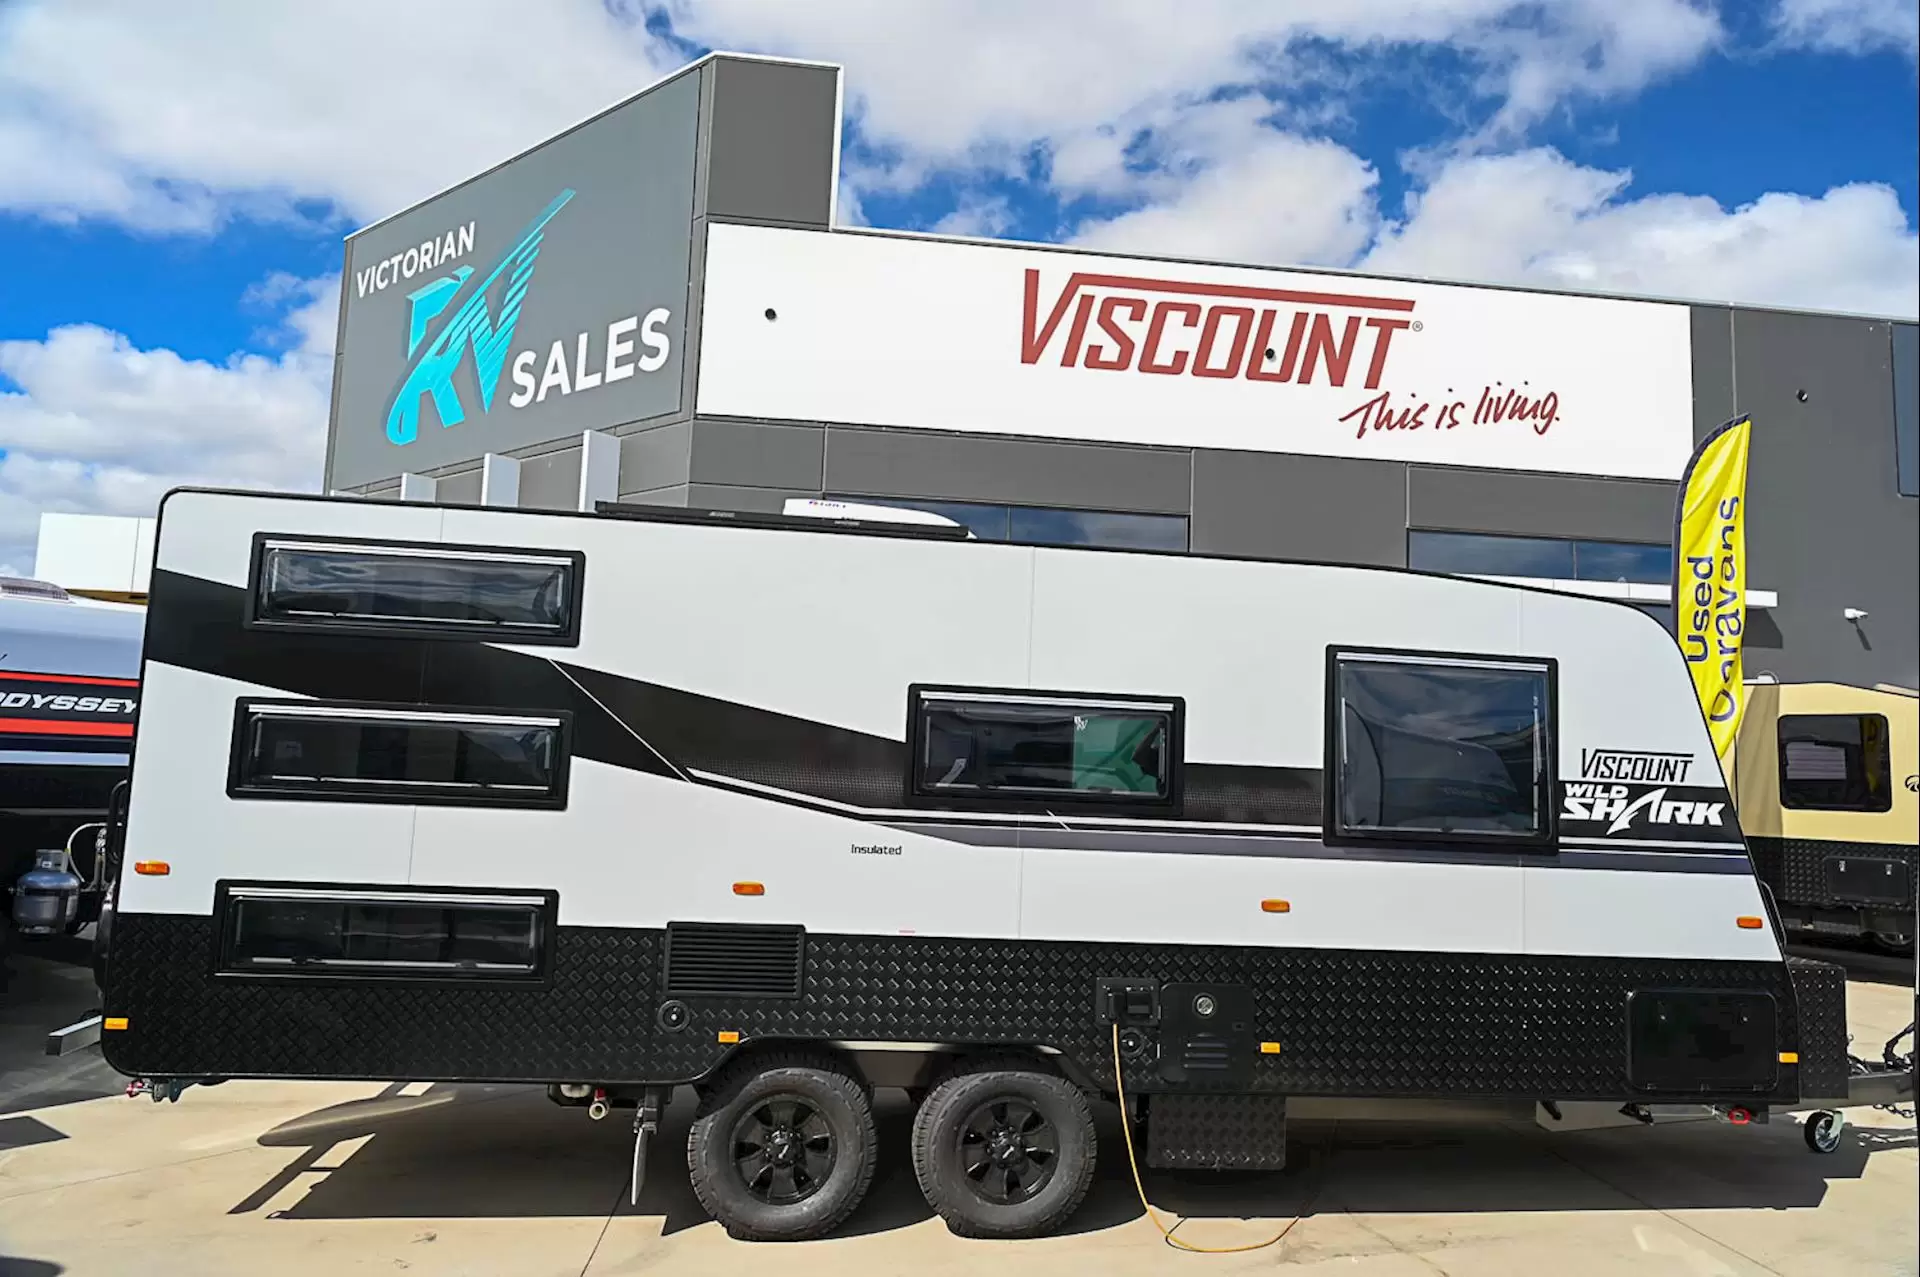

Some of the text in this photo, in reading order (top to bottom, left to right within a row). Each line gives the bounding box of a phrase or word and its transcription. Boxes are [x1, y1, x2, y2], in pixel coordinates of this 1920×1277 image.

[356, 220, 476, 298] VICTORIAN
[1020, 268, 1416, 390] VISCOUNT
[509, 307, 671, 409] SALES
[1338, 381, 1561, 440] This is living.
[1686, 555, 1714, 664] Used
[0, 692, 137, 713] DYSSEY
[1564, 783, 1629, 799] WILD
[1582, 748, 1694, 782] VISCOUNT
[1559, 787, 1726, 836] SHARK
[851, 843, 903, 855] Insulated
